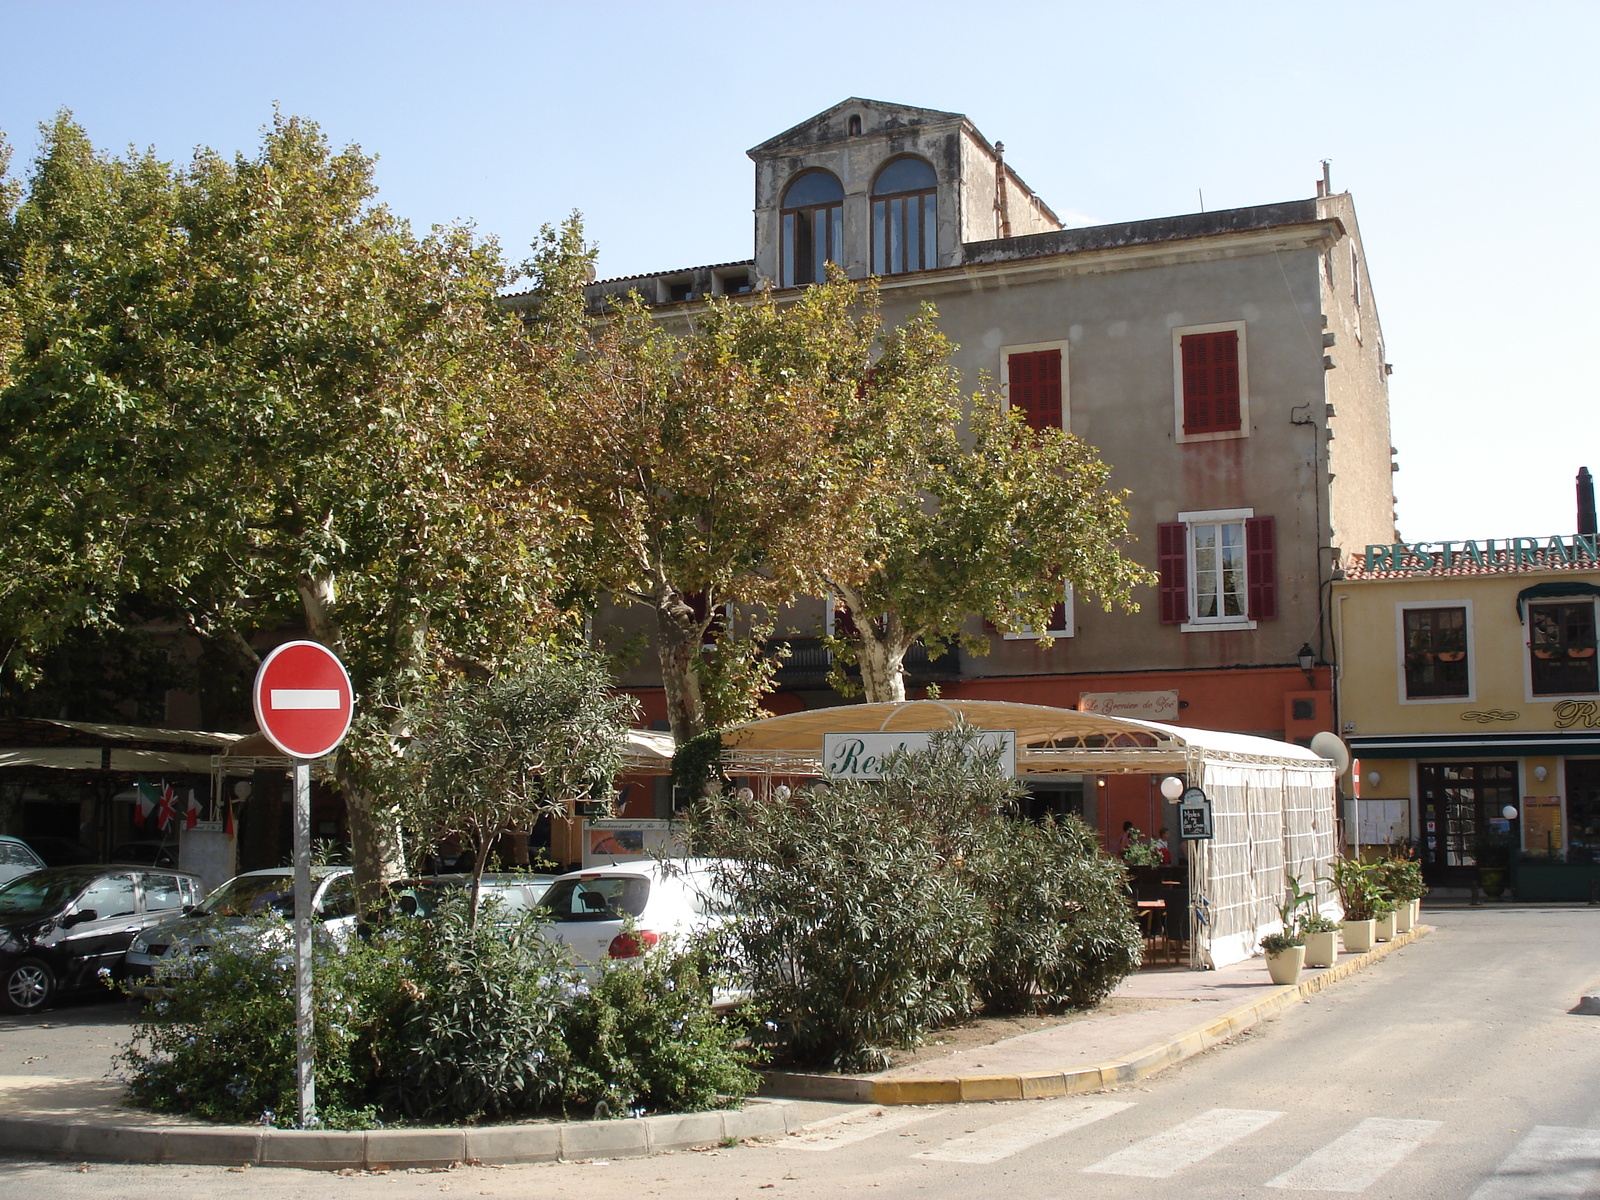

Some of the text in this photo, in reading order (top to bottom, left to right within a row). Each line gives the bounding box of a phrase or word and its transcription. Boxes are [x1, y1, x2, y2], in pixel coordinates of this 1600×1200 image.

[1084, 698, 1099, 711] Le
[1101, 698, 1139, 715] Grenier
[1143, 699, 1153, 709] de
